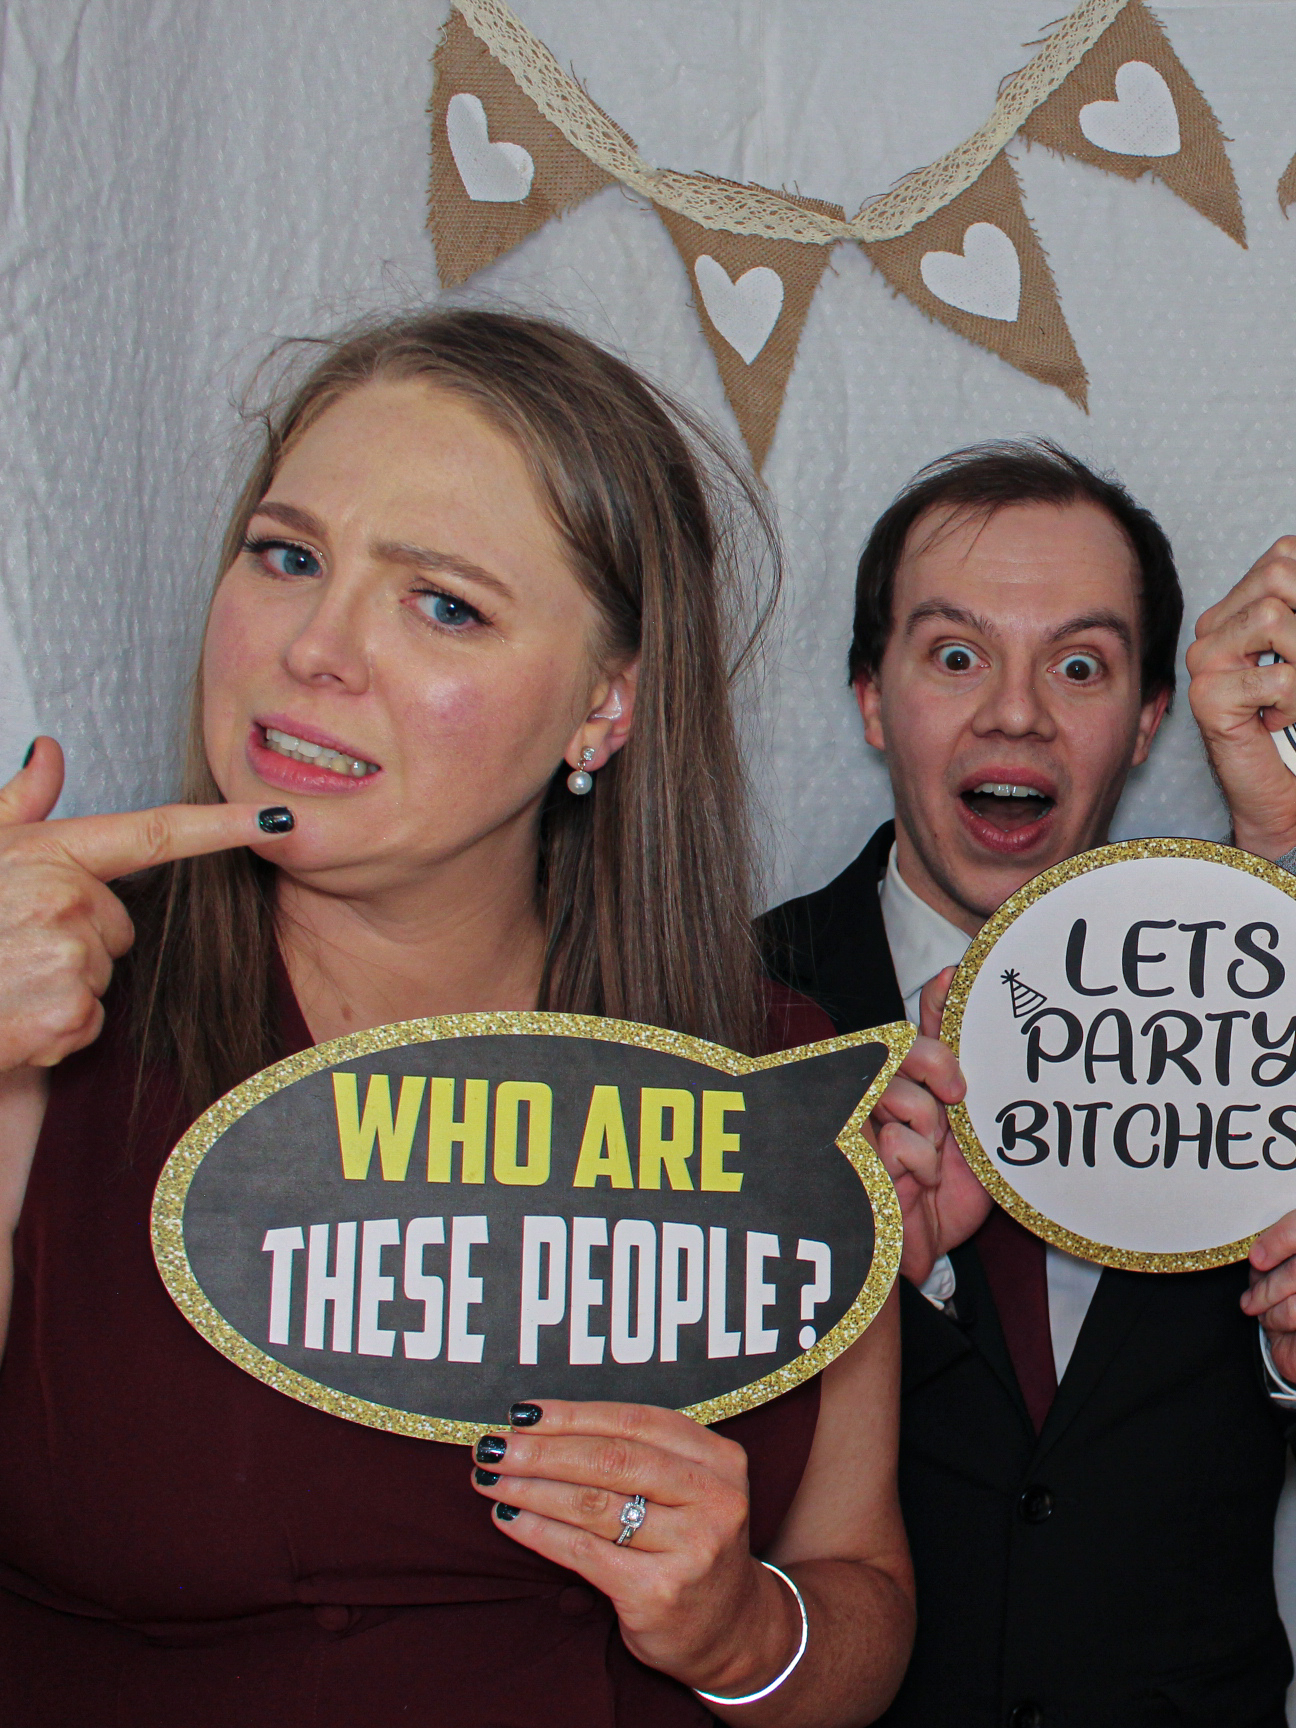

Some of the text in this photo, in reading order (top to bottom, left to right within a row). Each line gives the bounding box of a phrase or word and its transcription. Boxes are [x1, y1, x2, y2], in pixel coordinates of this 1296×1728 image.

[1065, 918, 1286, 999] LETS
[332, 1072, 747, 1193] WHO ARE
[261, 1215, 490, 1364] THESE
